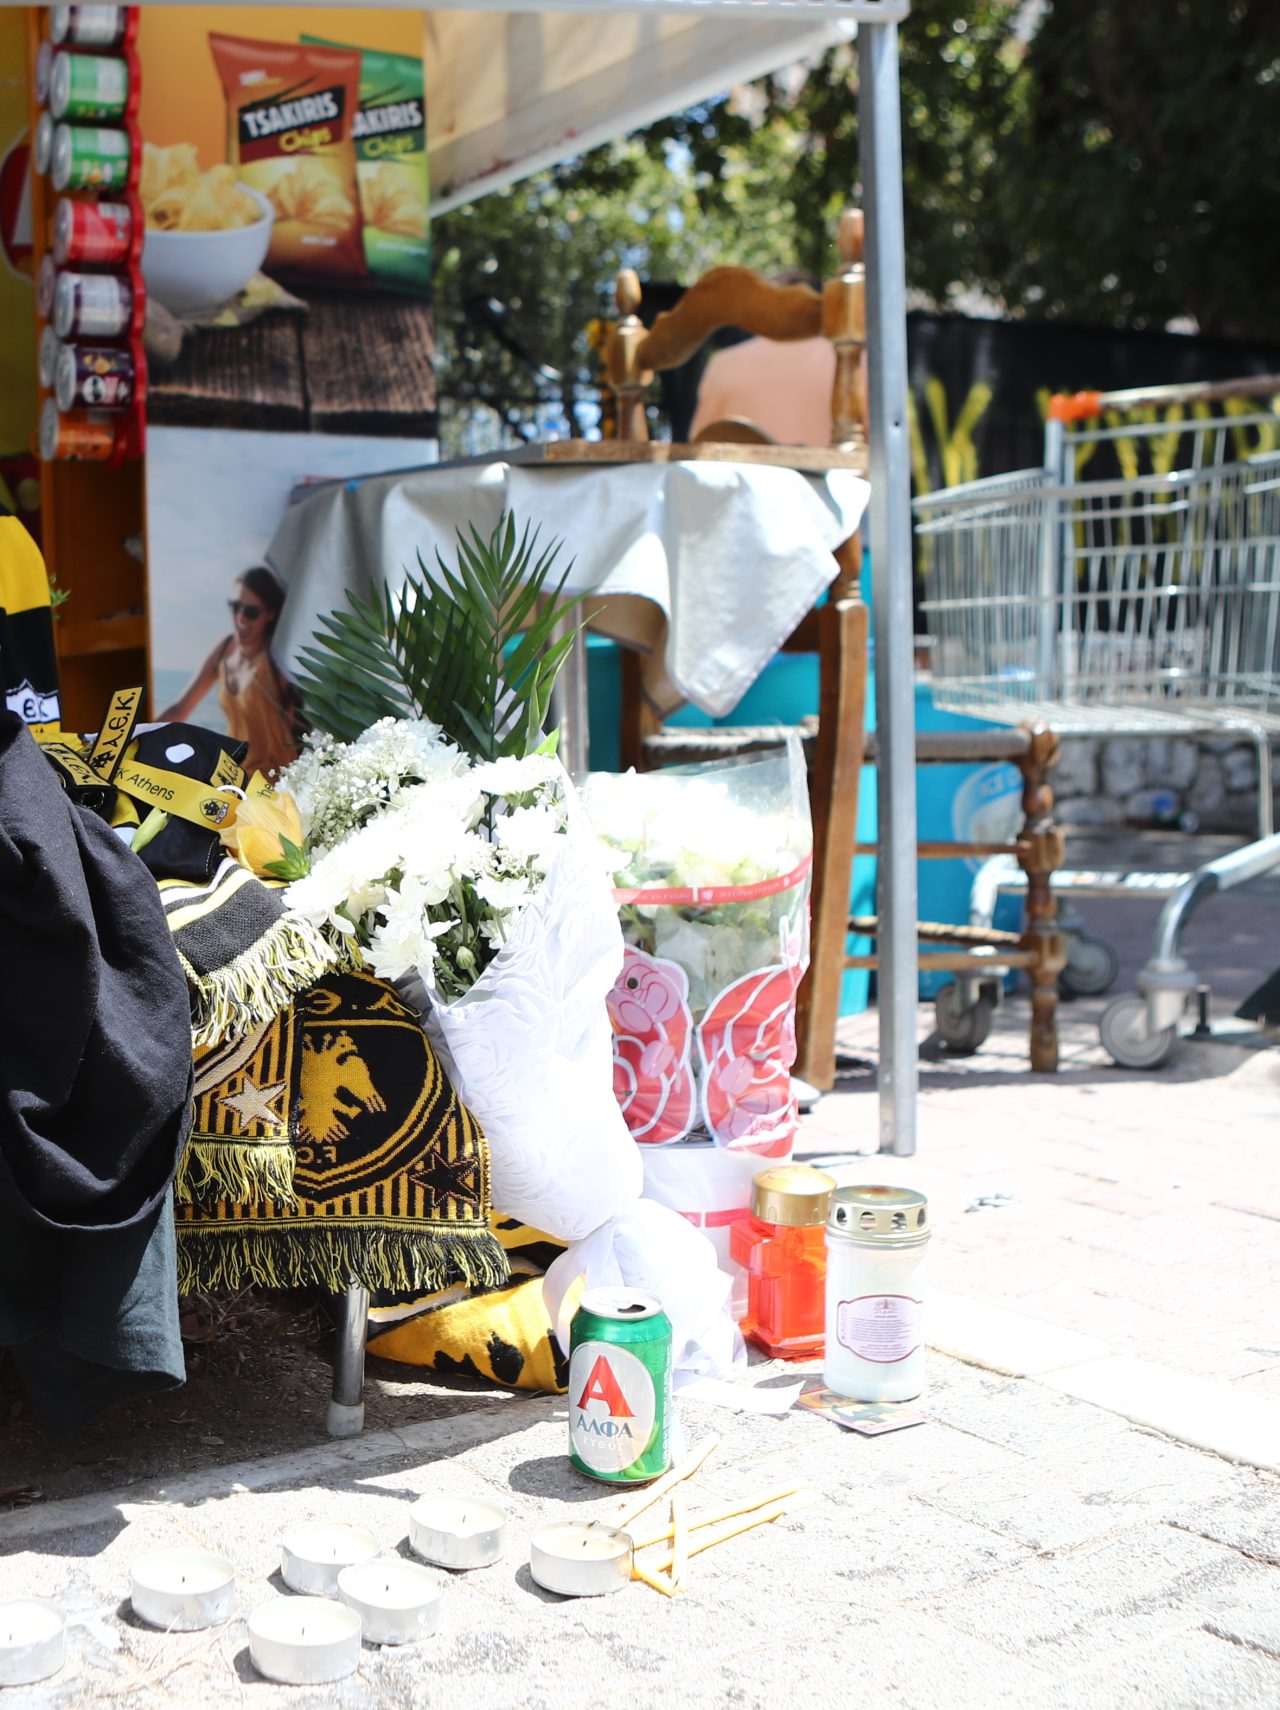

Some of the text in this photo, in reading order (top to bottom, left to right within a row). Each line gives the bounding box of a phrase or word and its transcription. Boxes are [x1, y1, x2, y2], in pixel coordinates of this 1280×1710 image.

[243, 91, 339, 138] TSAKIRIS
[279, 127, 332, 152] Chips
[127, 773, 175, 801] Athens
